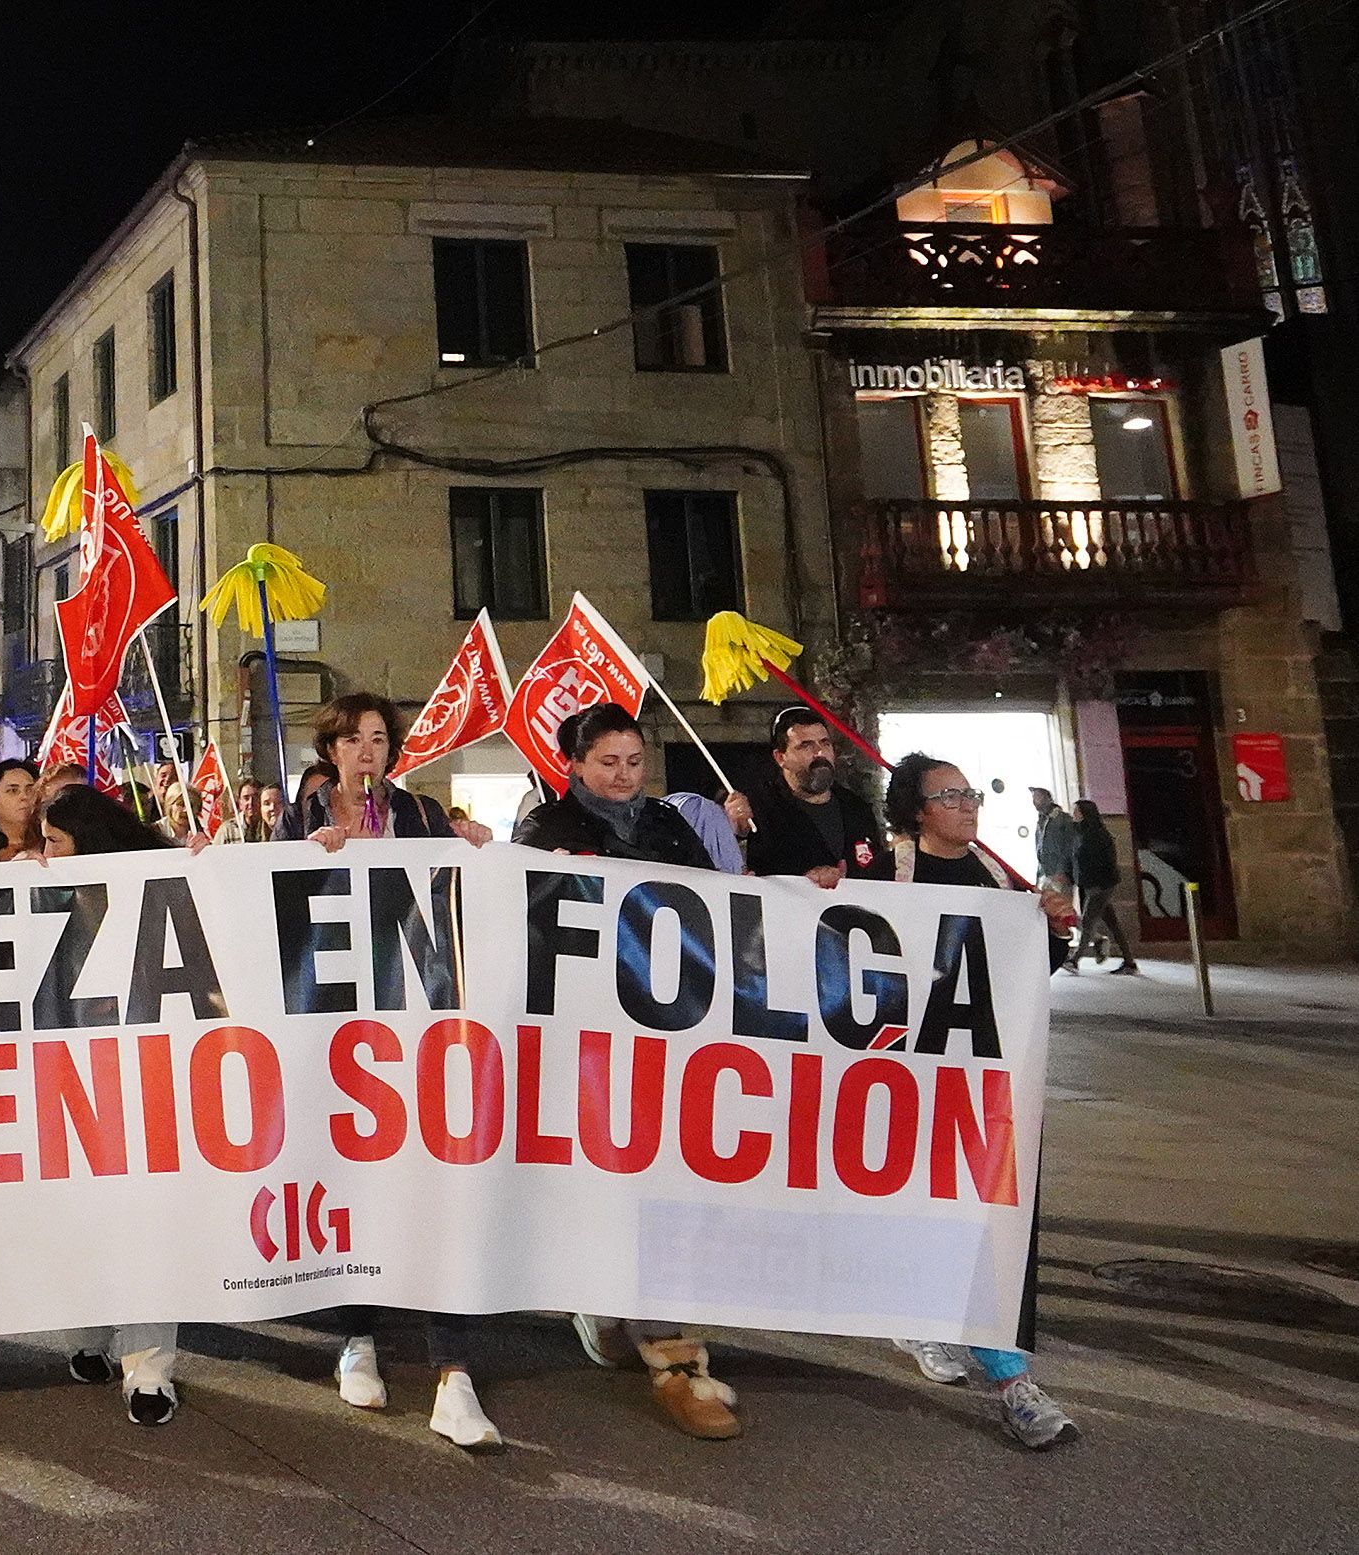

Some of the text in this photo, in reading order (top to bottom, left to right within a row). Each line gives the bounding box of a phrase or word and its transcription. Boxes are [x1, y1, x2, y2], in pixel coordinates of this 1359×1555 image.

[849, 357, 1026, 390] inmobiliaria
[1236, 708, 1247, 723] 3
[271, 866, 466, 1014] EN
[525, 869, 1002, 1059] FOLGA
[329, 1018, 1019, 1208] SOLUCIÓN
[249, 1180, 352, 1264] CIG
[223, 1263, 382, 1291] Confederación Intersindical Galega
